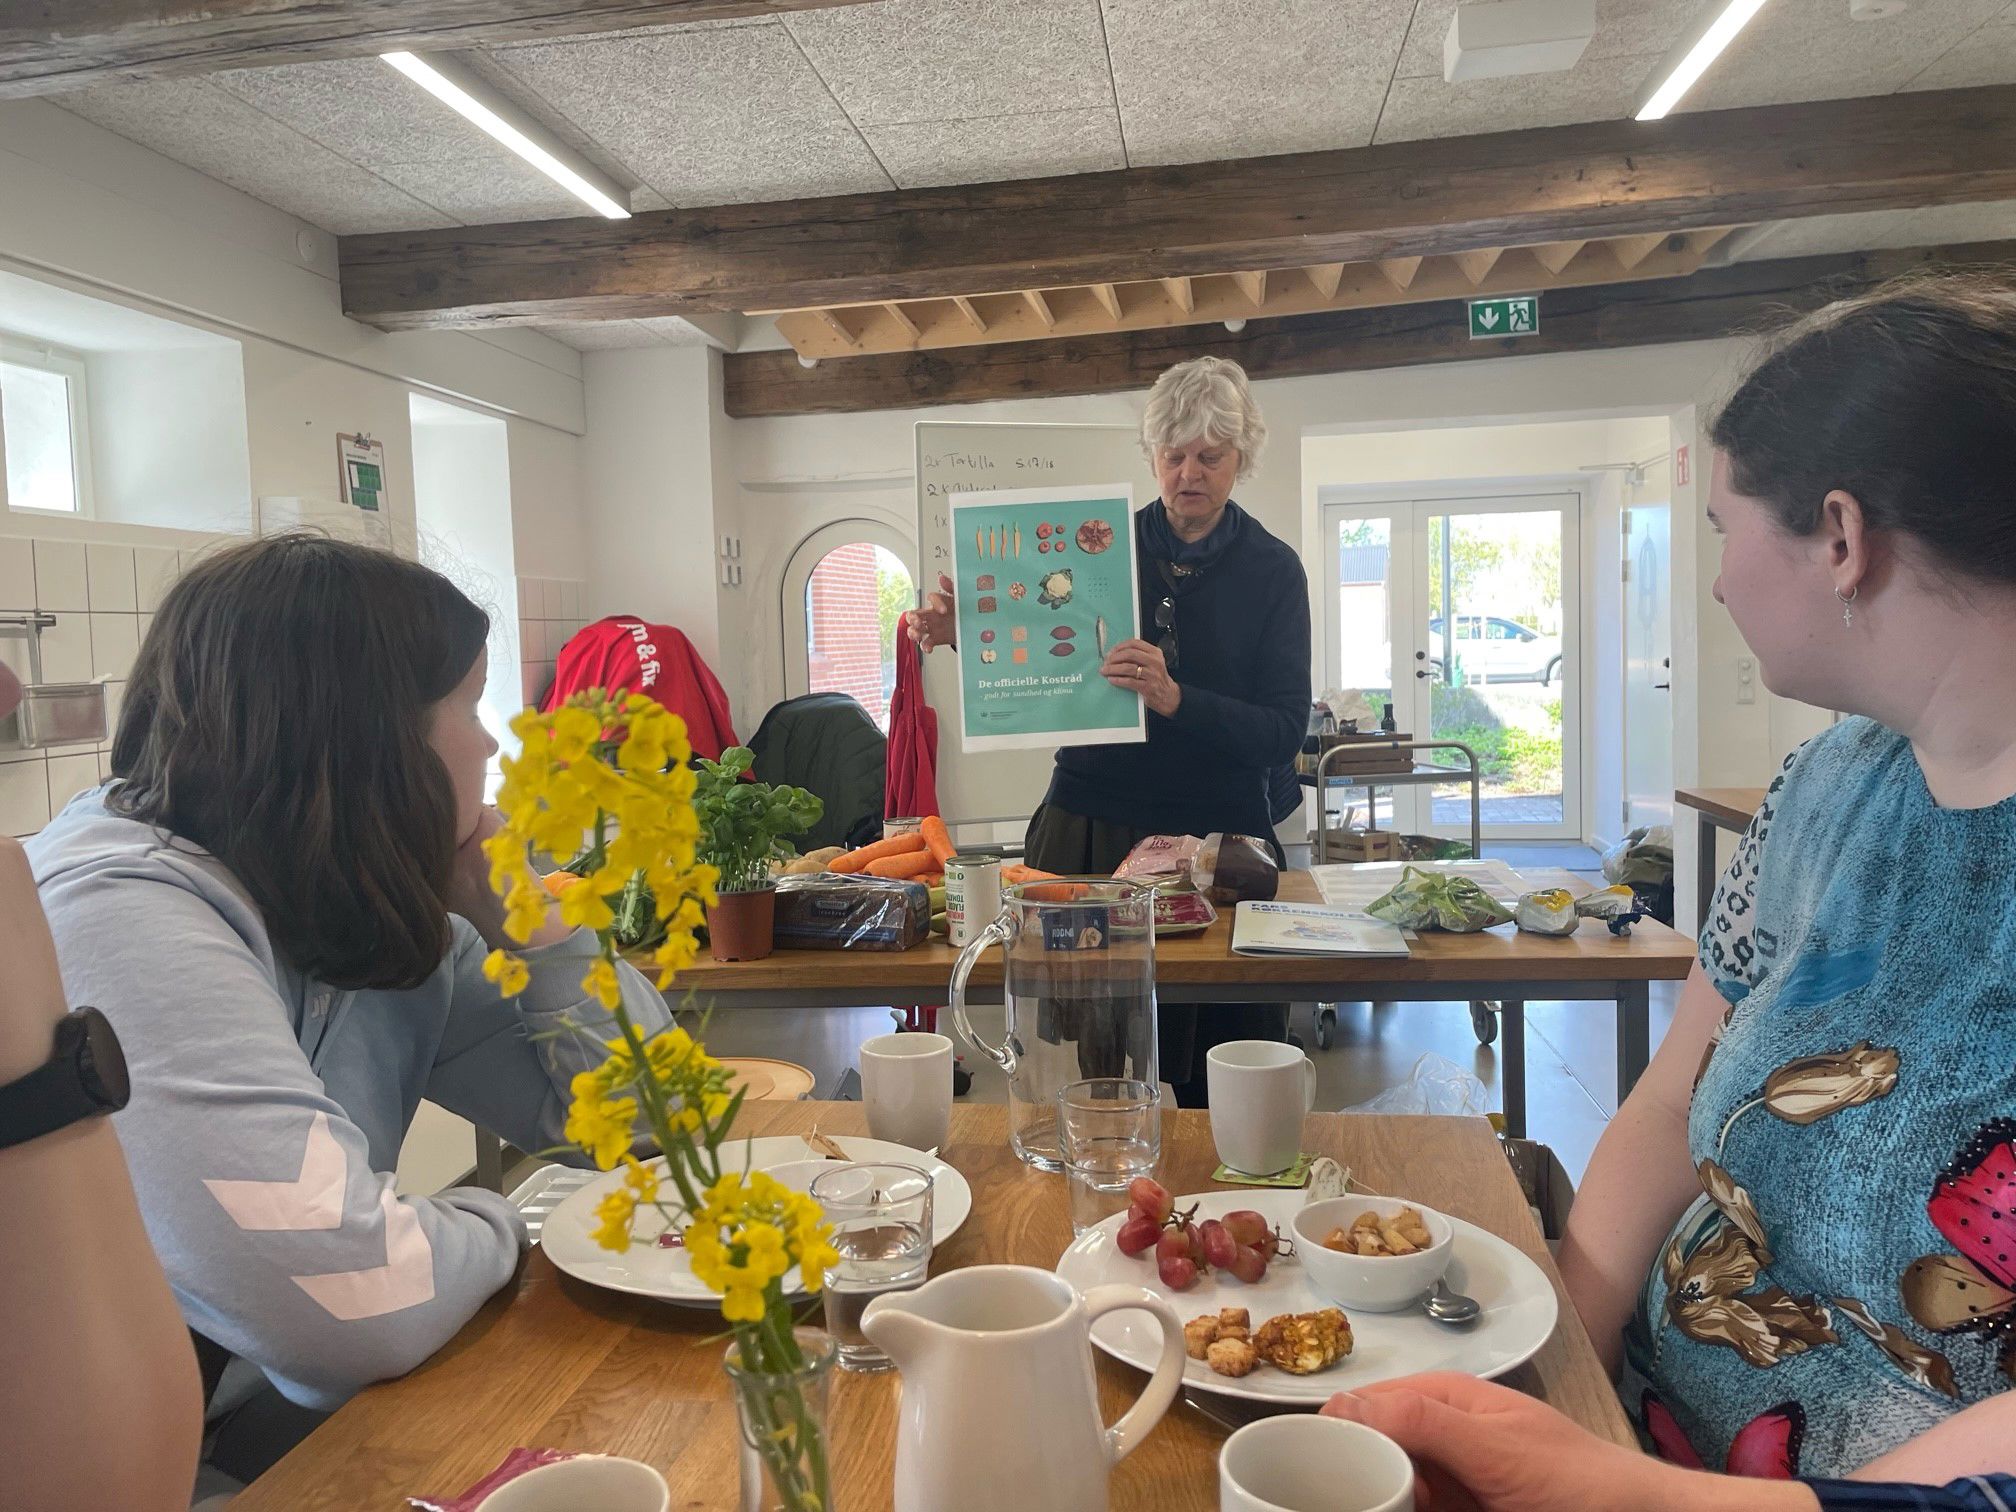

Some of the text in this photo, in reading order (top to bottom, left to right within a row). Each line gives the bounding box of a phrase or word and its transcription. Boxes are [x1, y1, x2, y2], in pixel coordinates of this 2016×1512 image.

[641, 659, 661, 688] fix
[978, 673, 1083, 689] De officielle Kostråd
[1000, 690, 1012, 700] for
[1013, 689, 1043, 698] sundhed
[1044, 689, 1052, 697] og
